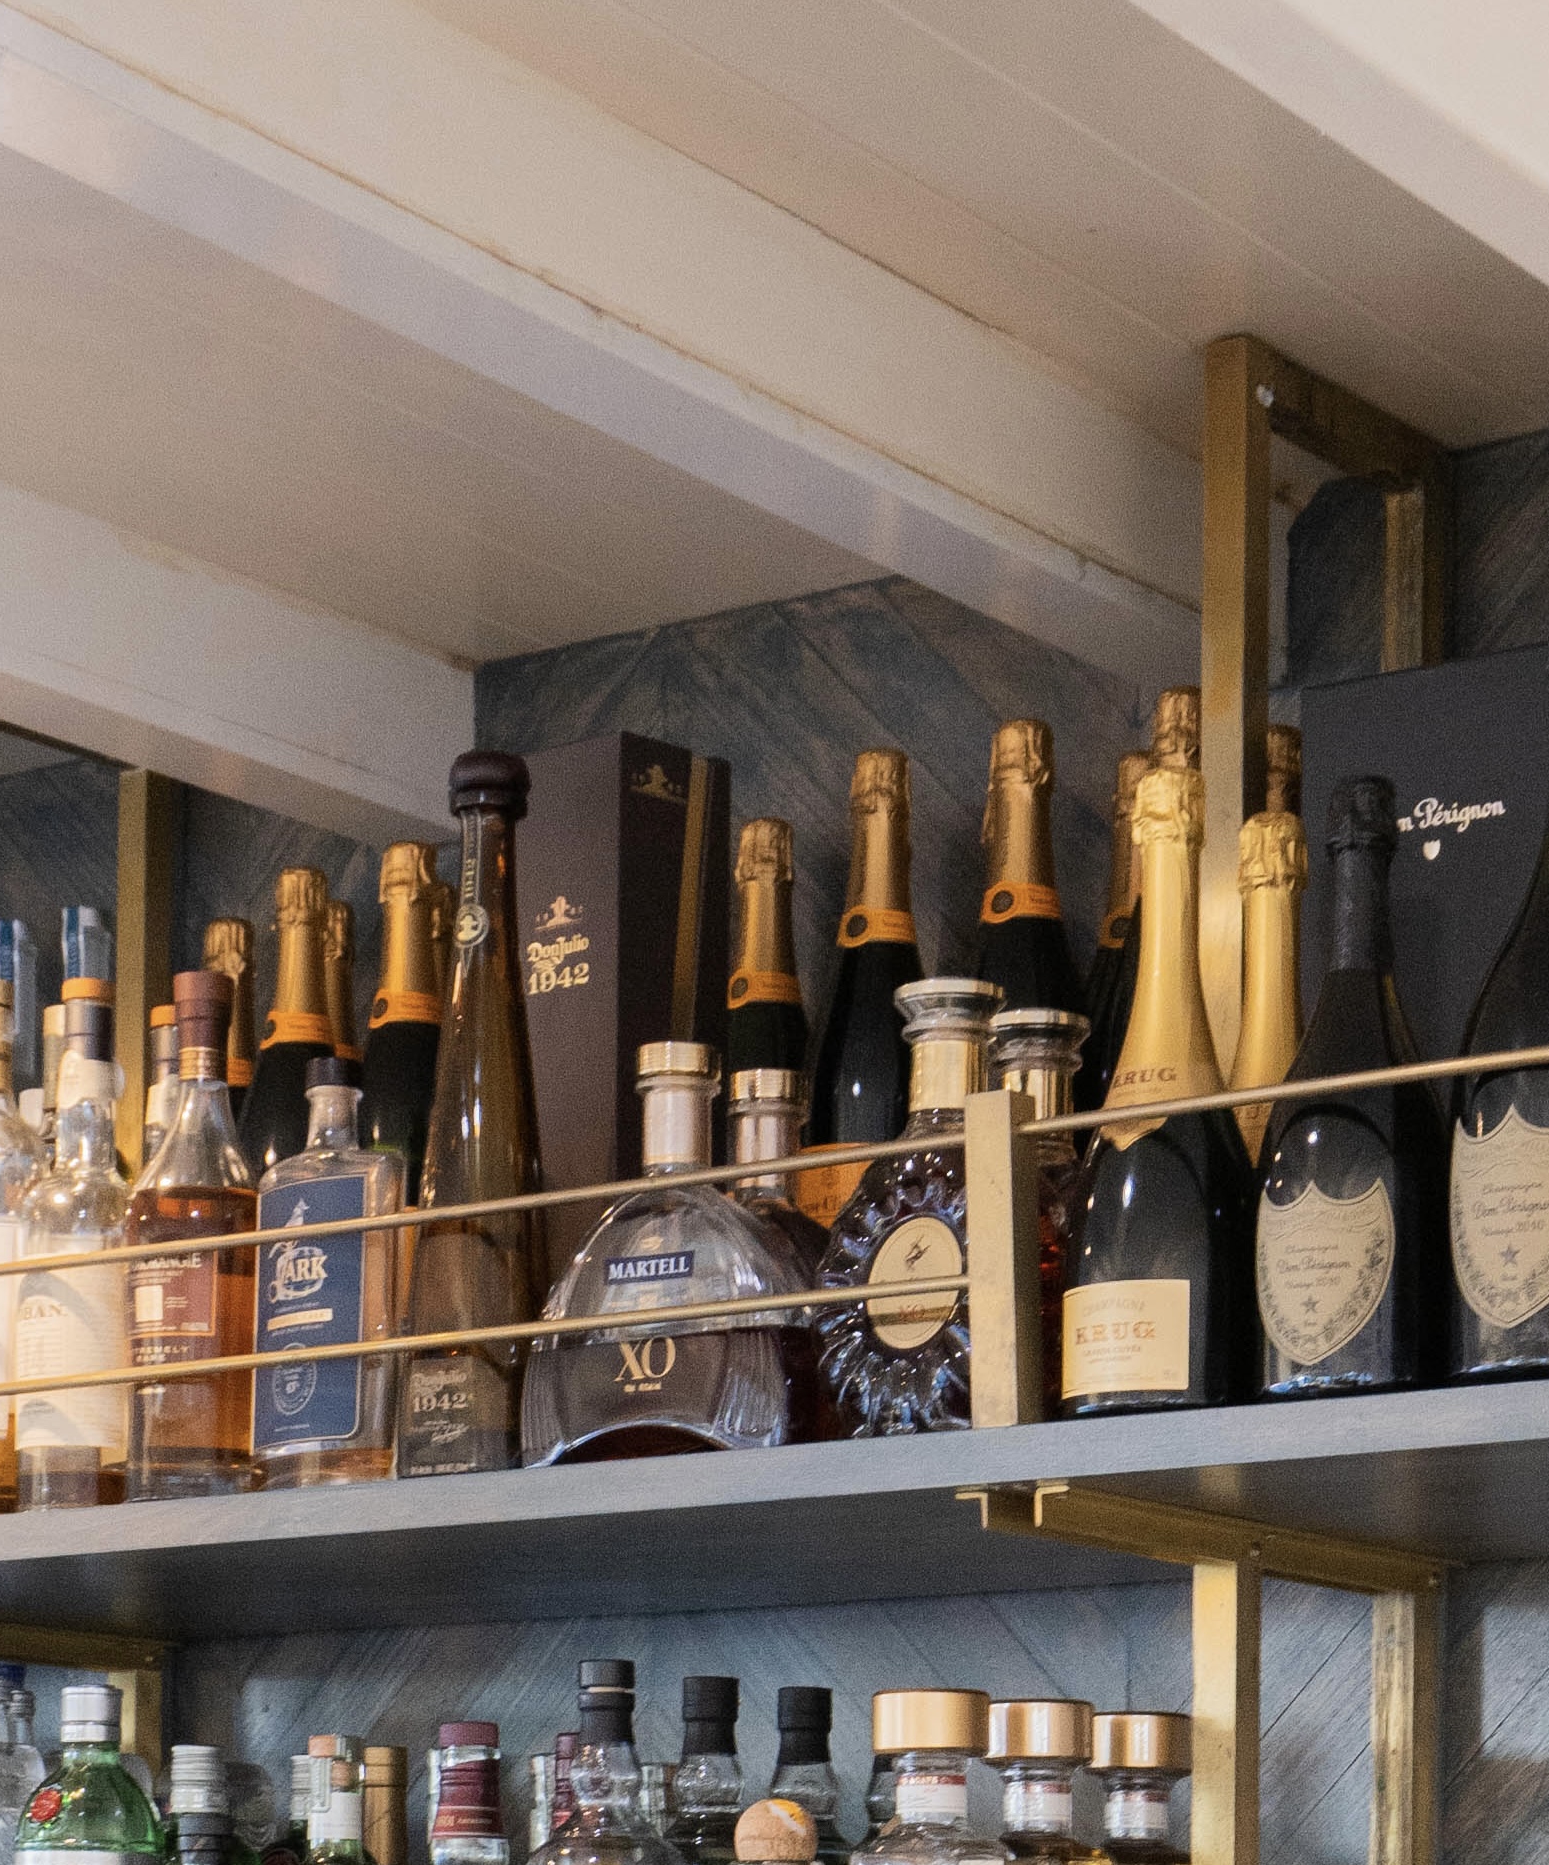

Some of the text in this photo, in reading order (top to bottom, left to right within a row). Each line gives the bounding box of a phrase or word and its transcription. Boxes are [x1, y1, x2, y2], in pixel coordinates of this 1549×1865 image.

[1413, 796, 1506, 834] Pérignon
[527, 963, 590, 995] 1942
[608, 1254, 691, 1281] MARTELL
[1075, 1320, 1157, 1346] KRUG
[614, 1335, 677, 1382] XO
[412, 1391, 469, 1414] 1942
